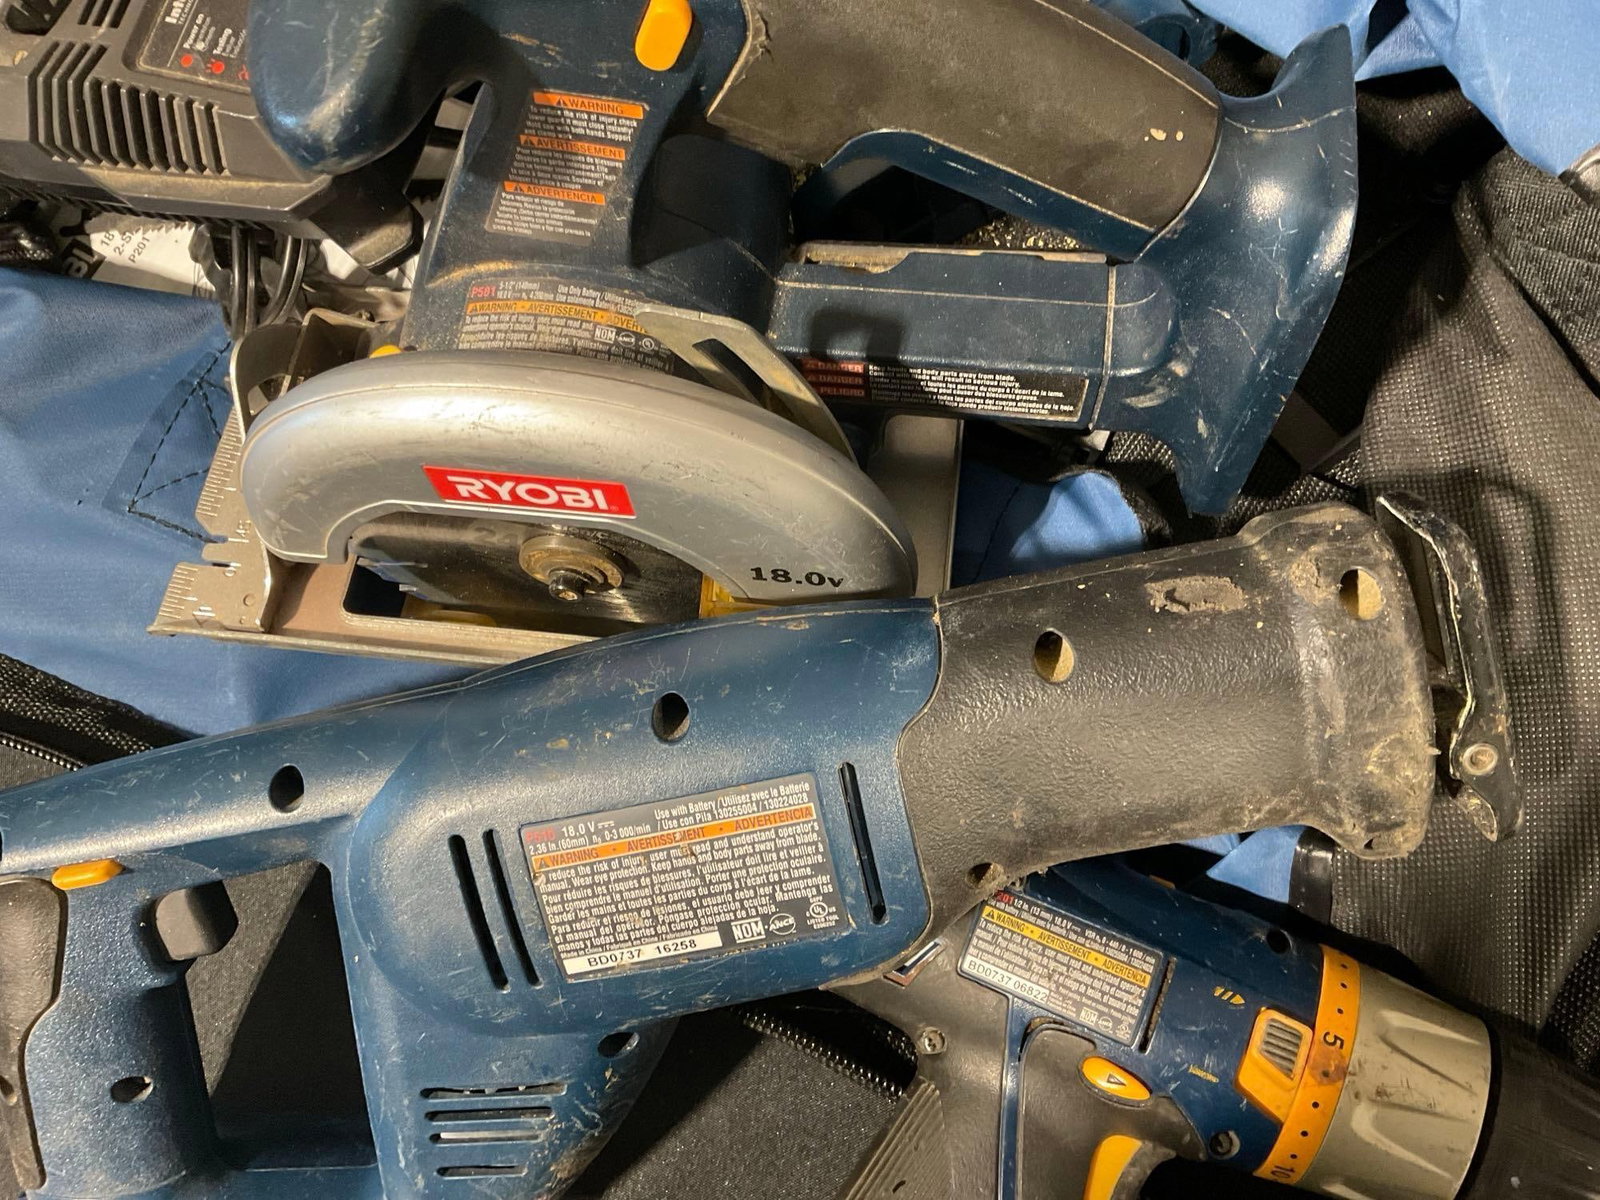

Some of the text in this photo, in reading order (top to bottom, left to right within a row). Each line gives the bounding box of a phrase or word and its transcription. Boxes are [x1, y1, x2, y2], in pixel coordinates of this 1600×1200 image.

[183, 24, 199, 48] Power
[568, 98, 624, 114] WARNING
[538, 138, 622, 157] AVERTISSEMENT
[527, 186, 597, 202] ADVERTENCIA
[128, 236, 150, 263] P201
[472, 285, 496, 297] P501
[479, 302, 597, 319] WARNING AVERTISSEMENT
[595, 328, 616, 342] NOM
[818, 362, 864, 373] DANGER
[820, 374, 862, 384] DANGER
[820, 387, 864, 396] PELIGRO
[447, 476, 609, 510] RYOBI
[750, 567, 844, 587] 18.0v
[654, 781, 810, 820] Use with Battery Utilisez avec le Batterie
[661, 792, 808, 829] Use con Pila 130255004 130224028
[528, 842, 547, 856] 2.36
[618, 823, 651, 838] 000/min
[548, 846, 600, 868] WARNING
[624, 825, 708, 853] AVERTISSEMENT
[732, 805, 814, 832] ADVERTENCIA
[561, 823, 585, 837] 18.0
[537, 879, 571, 893] manual.
[571, 876, 592, 887] Wear
[594, 872, 608, 884] eye
[609, 864, 650, 882] protection.
[650, 860, 671, 872] Keep
[671, 855, 696, 868] hands
[696, 851, 712, 863] and
[712, 848, 732, 860] body
[733, 844, 753, 857] parts
[754, 840, 774, 852] away
[775, 836, 795, 848] from
[795, 831, 821, 844] blade.
[548, 868, 576, 881] reduce
[577, 865, 591, 875] the
[593, 860, 609, 872] risk
[610, 858, 619, 869] of
[649, 850, 667, 863] user
[692, 840, 711, 854] read
[713, 837, 729, 849] and
[730, 828, 775, 846] understand
[778, 820, 819, 837] operator's
[541, 842, 824, 906] Pour réduire les risques de blessures, l'utilisateur doit lire et veiller à
[544, 854, 826, 916] bien comprendre le manuel d'utilisation. Porter une protection oculaire.
[548, 866, 814, 924] Garder les mains et toutes les parties du corps à l'écart de la lame.
[550, 874, 830, 935] Para reducir el riesgo de lesiones, el usuario debe leer y comprender
[554, 884, 833, 947] el manual del Póngase protección ocular. Mantenga las
[557, 903, 779, 955] manos y todas las partes del cuerpo alejadas de la hoja.
[732, 920, 765, 941] NOM
[587, 939, 697, 967] BD0737 16258
[994, 912, 1147, 985] WARNING AVERTISSEMENT ADVERTENCIA
[967, 959, 1047, 1003] BD0737 06822
[1323, 1031, 1344, 1050] 5
[1270, 1165, 1295, 1178] 10
